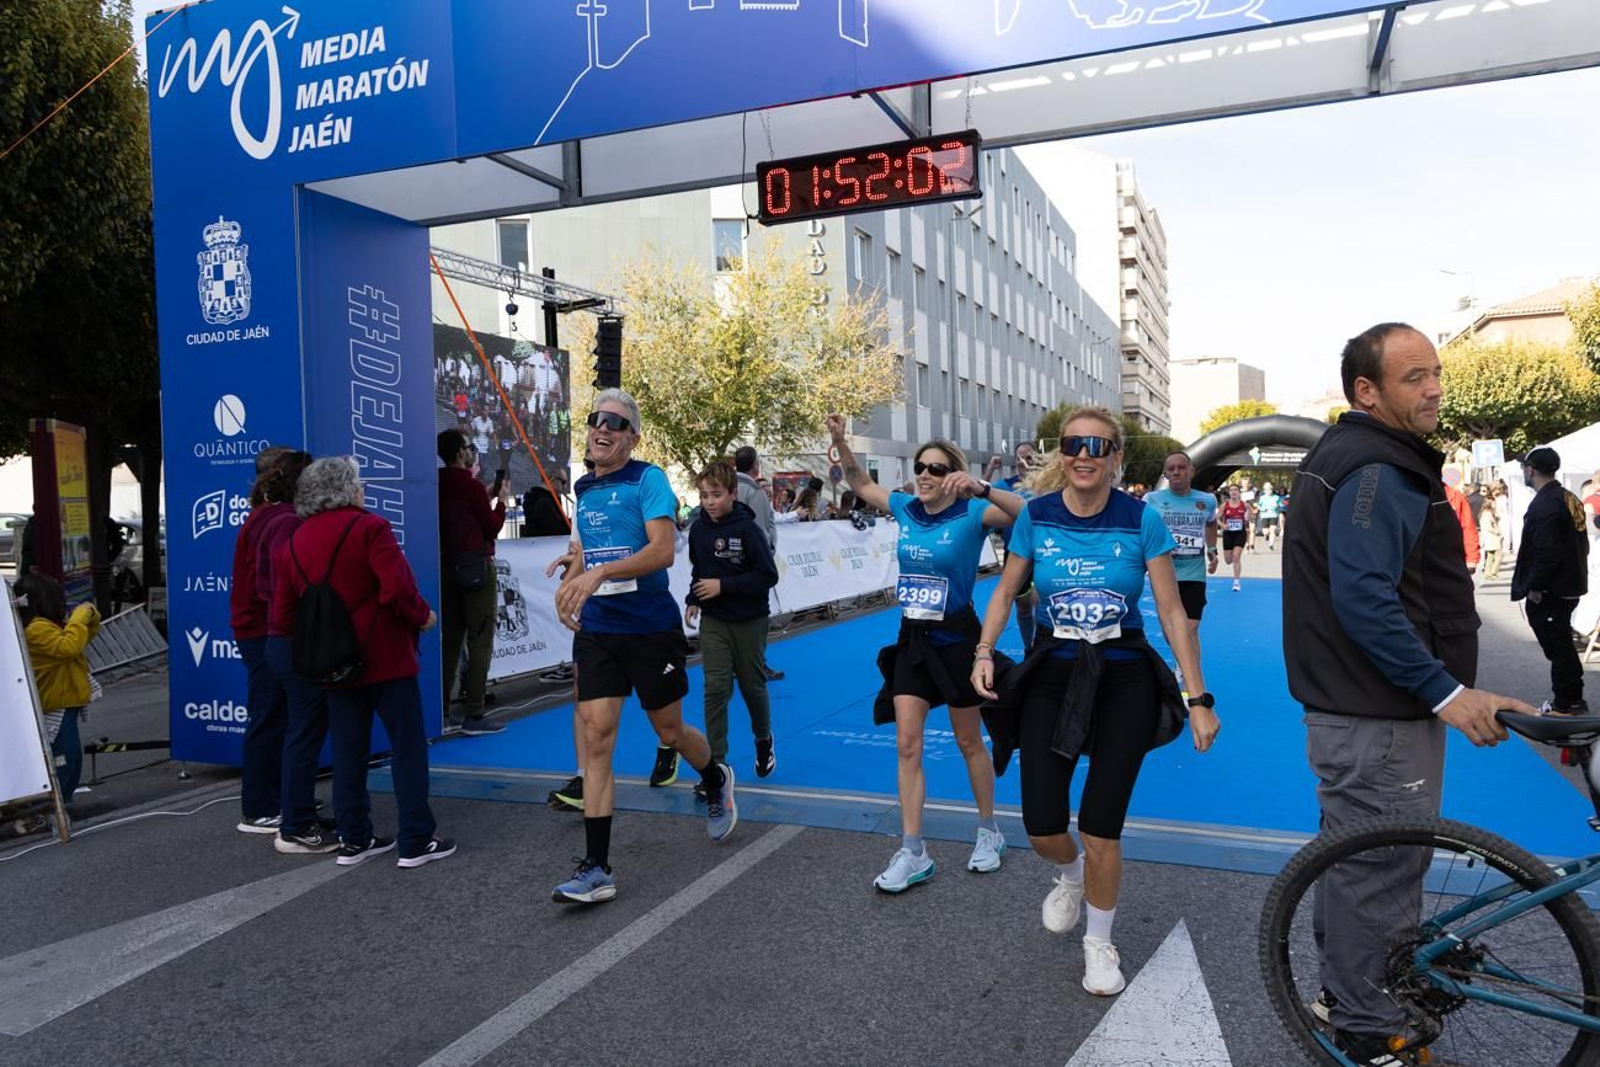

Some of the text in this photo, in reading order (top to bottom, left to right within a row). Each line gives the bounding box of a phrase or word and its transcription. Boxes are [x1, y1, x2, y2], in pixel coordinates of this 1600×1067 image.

[300, 26, 386, 69] MEDIA
[295, 57, 429, 111] MARATÓN
[288, 113, 353, 154] JAÉN
[766, 141, 966, 215] 01:52:02
[186, 324, 270, 346] CIUDAD DE JAÉN
[184, 571, 233, 591] JAÉN
[898, 586, 942, 605] 2399
[1054, 602, 1121, 623] 2032
[491, 646, 516, 659] IUDAD
[516, 644, 528, 655] DE
[184, 699, 251, 723] calde
